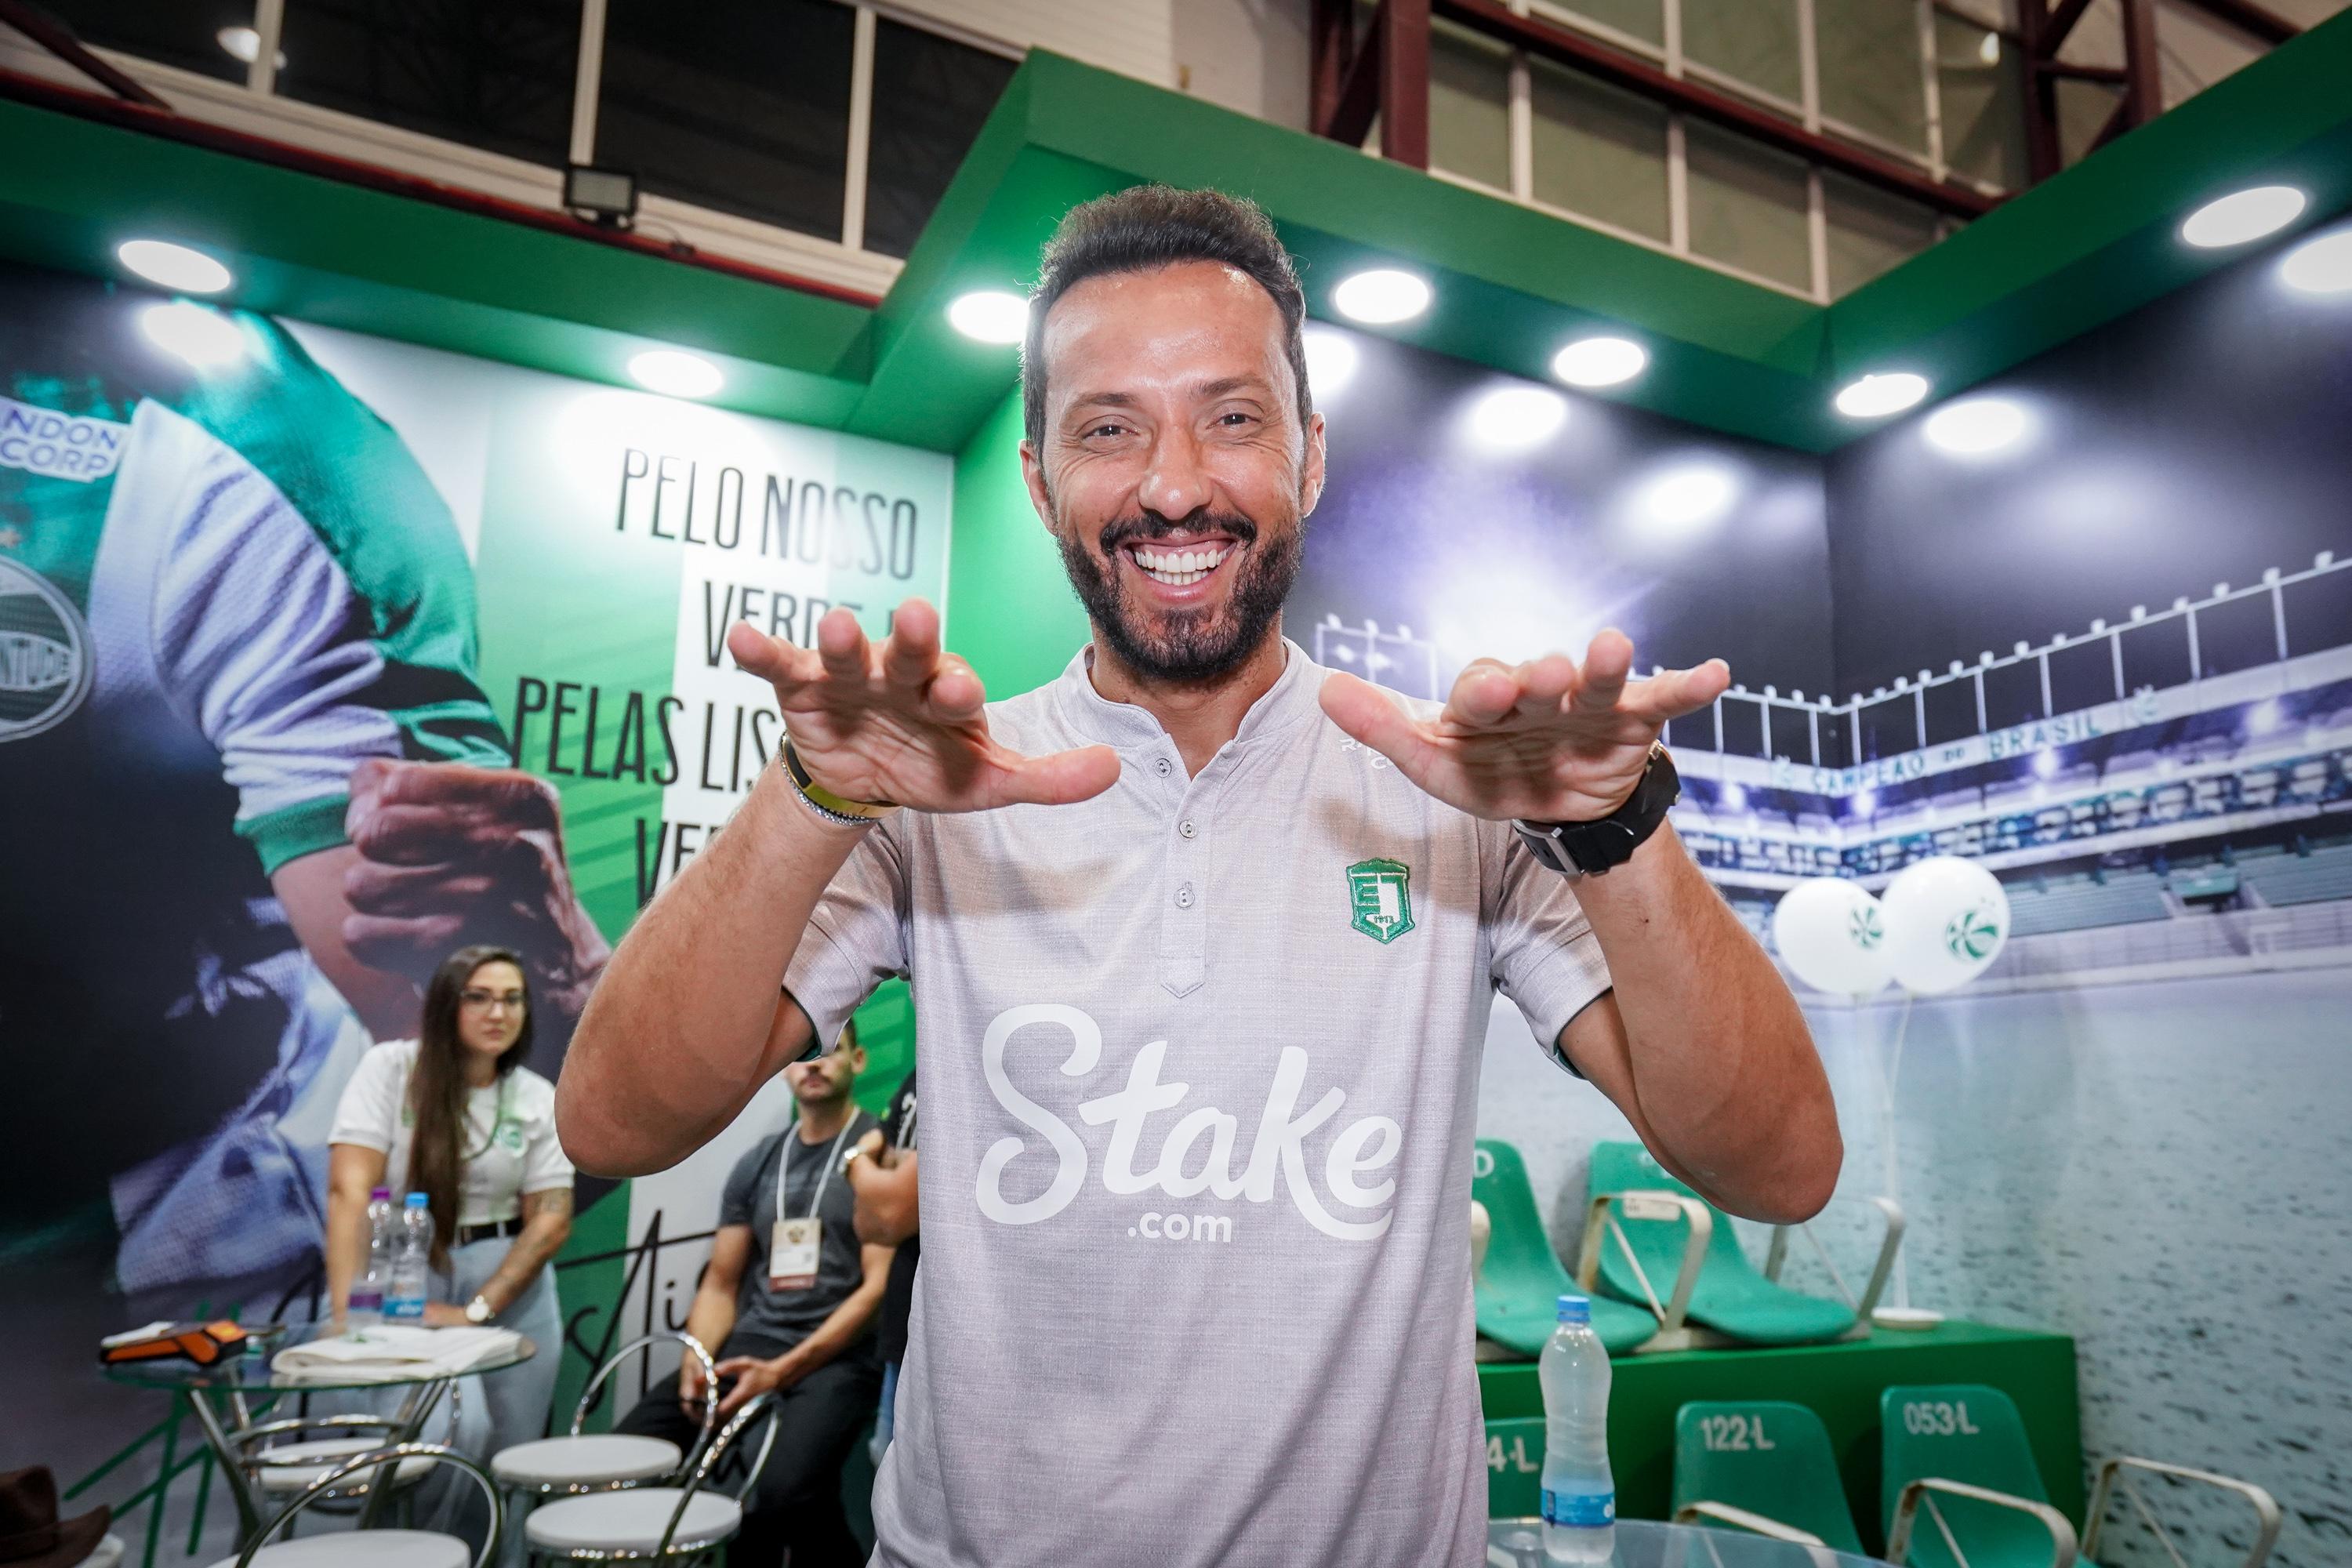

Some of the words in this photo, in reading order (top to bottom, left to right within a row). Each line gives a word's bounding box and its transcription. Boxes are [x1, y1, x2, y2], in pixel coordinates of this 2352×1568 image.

[0, 437, 109, 474] CORP
[616, 448, 744, 550] PELO
[761, 474, 919, 581] NOSSO
[511, 676, 684, 787] PELAS
[975, 1004, 1403, 1241] Stake
[1127, 1212, 1232, 1243] .com
